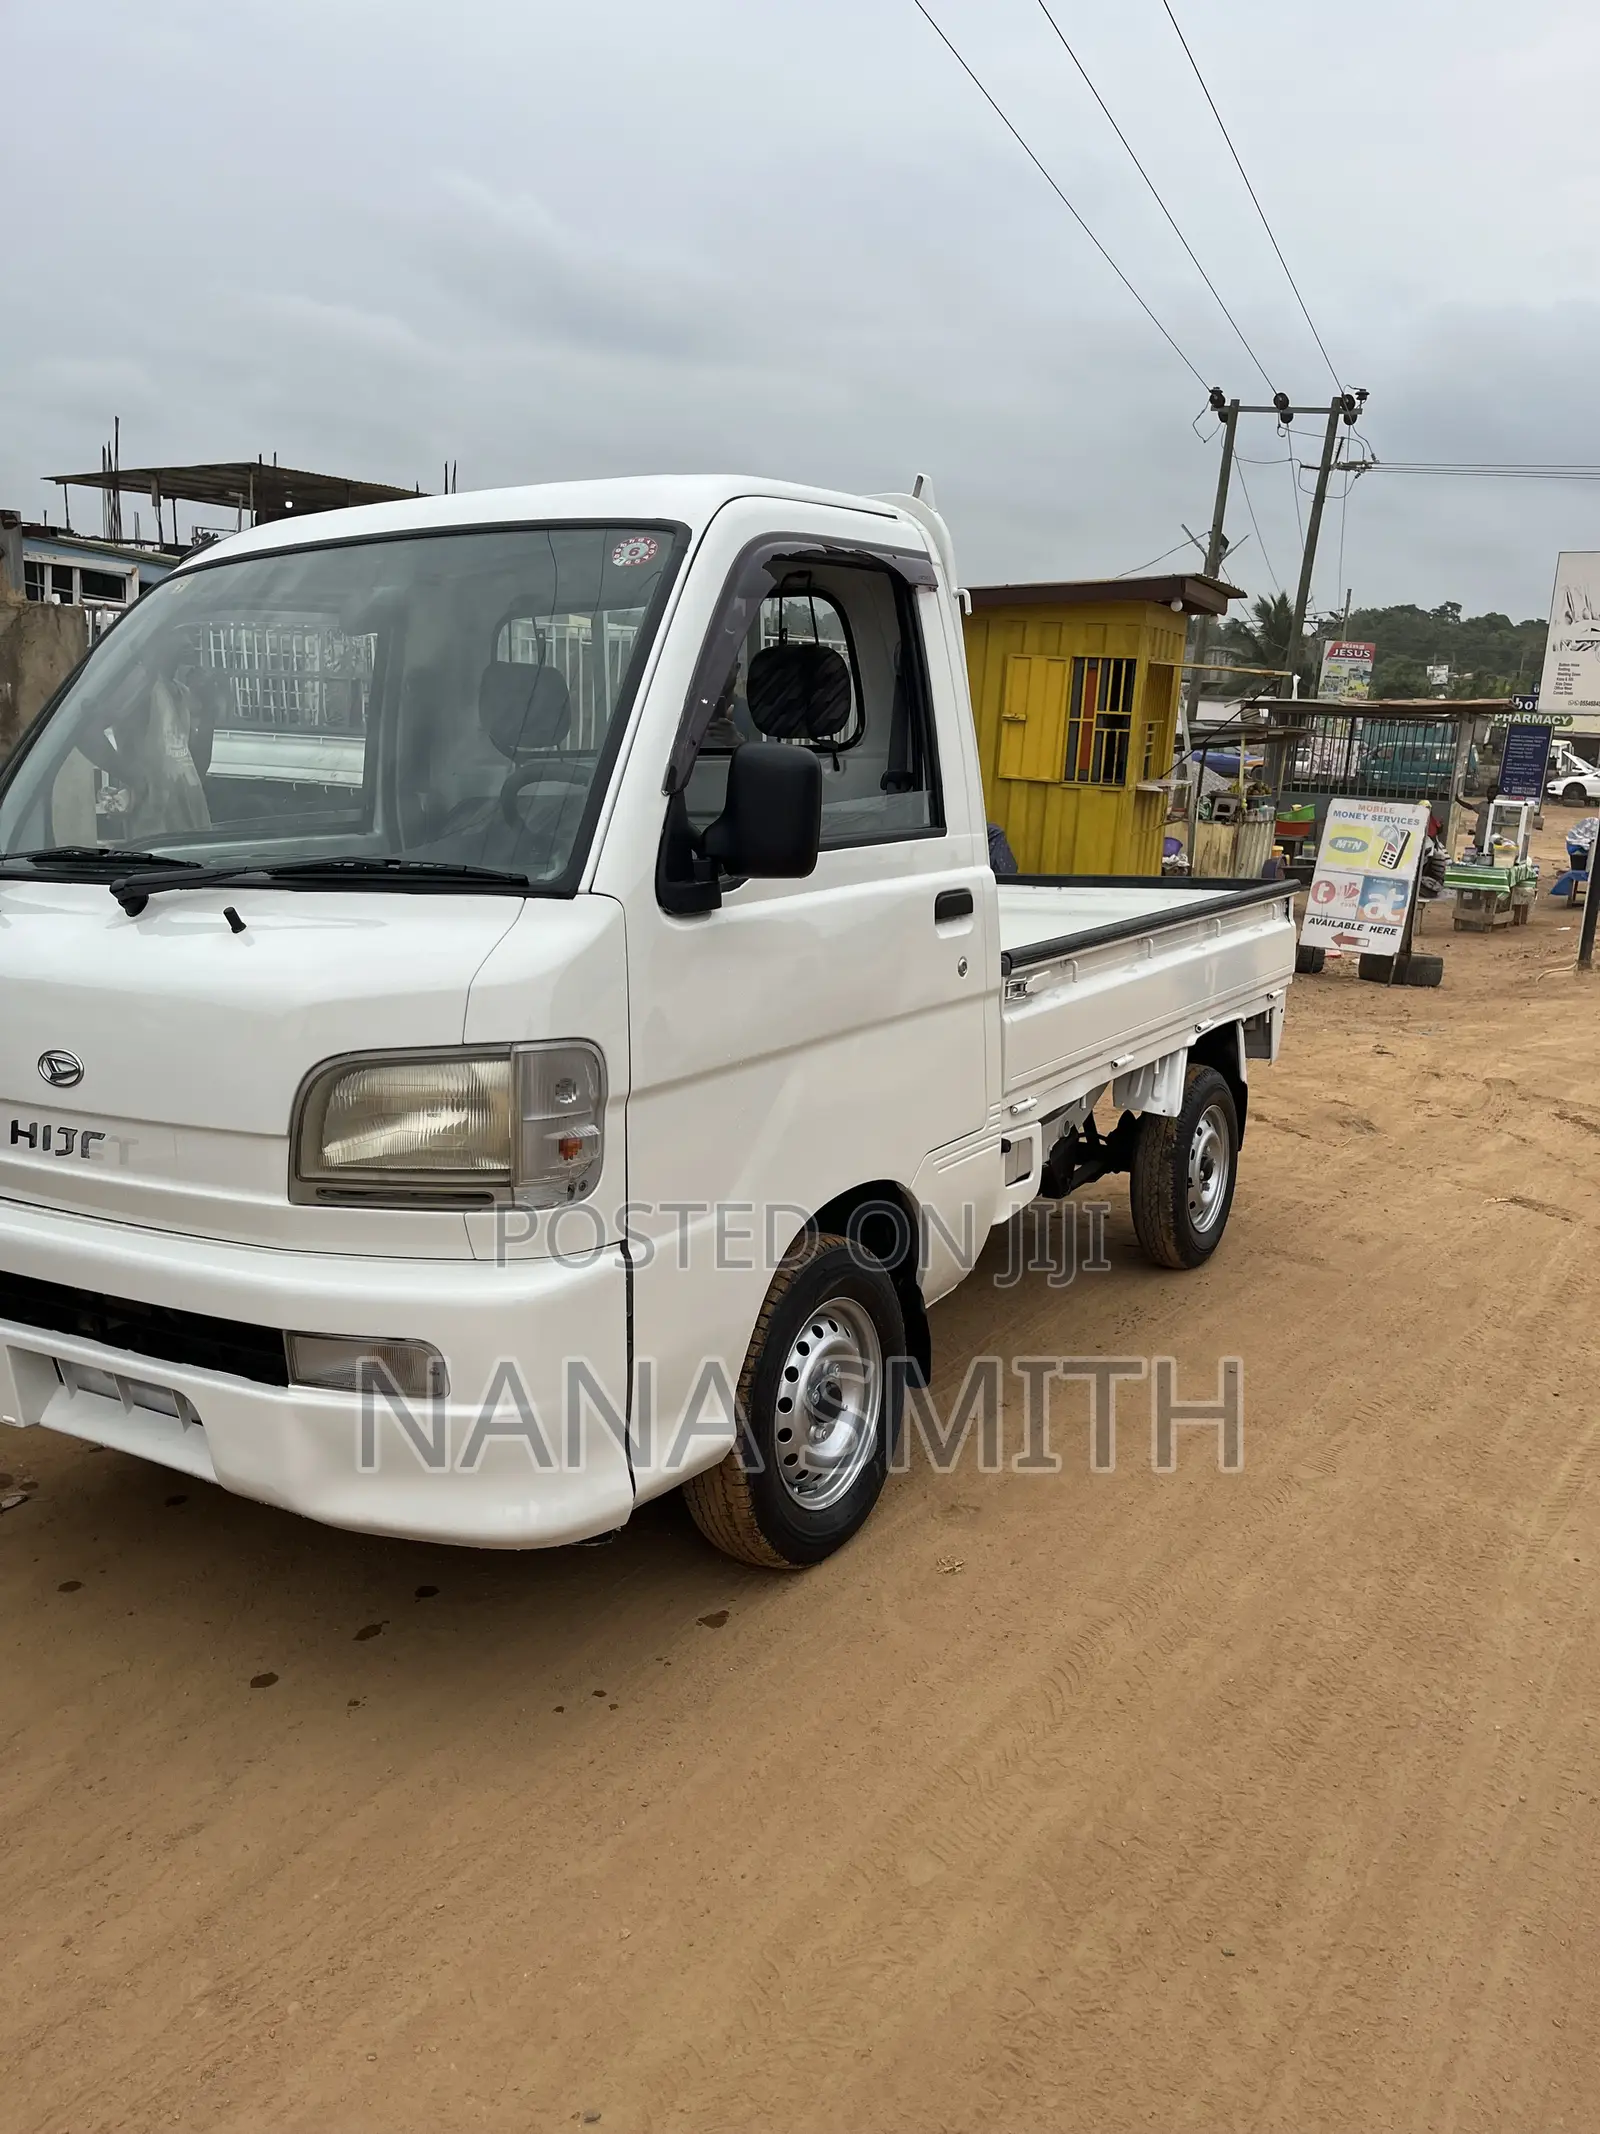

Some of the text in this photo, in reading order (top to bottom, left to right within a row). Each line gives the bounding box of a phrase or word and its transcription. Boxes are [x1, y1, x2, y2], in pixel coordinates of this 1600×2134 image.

[629, 547, 640, 556] 6
[1332, 648, 1371, 658] JESUS
[1494, 713, 1570, 725] PHARMACY
[1357, 804, 1395, 814] MOBILE
[1333, 810, 1420, 826] MONEY SERVICES
[1336, 839, 1363, 850] MTN
[1308, 917, 1398, 936] AVAILABLE HERE
